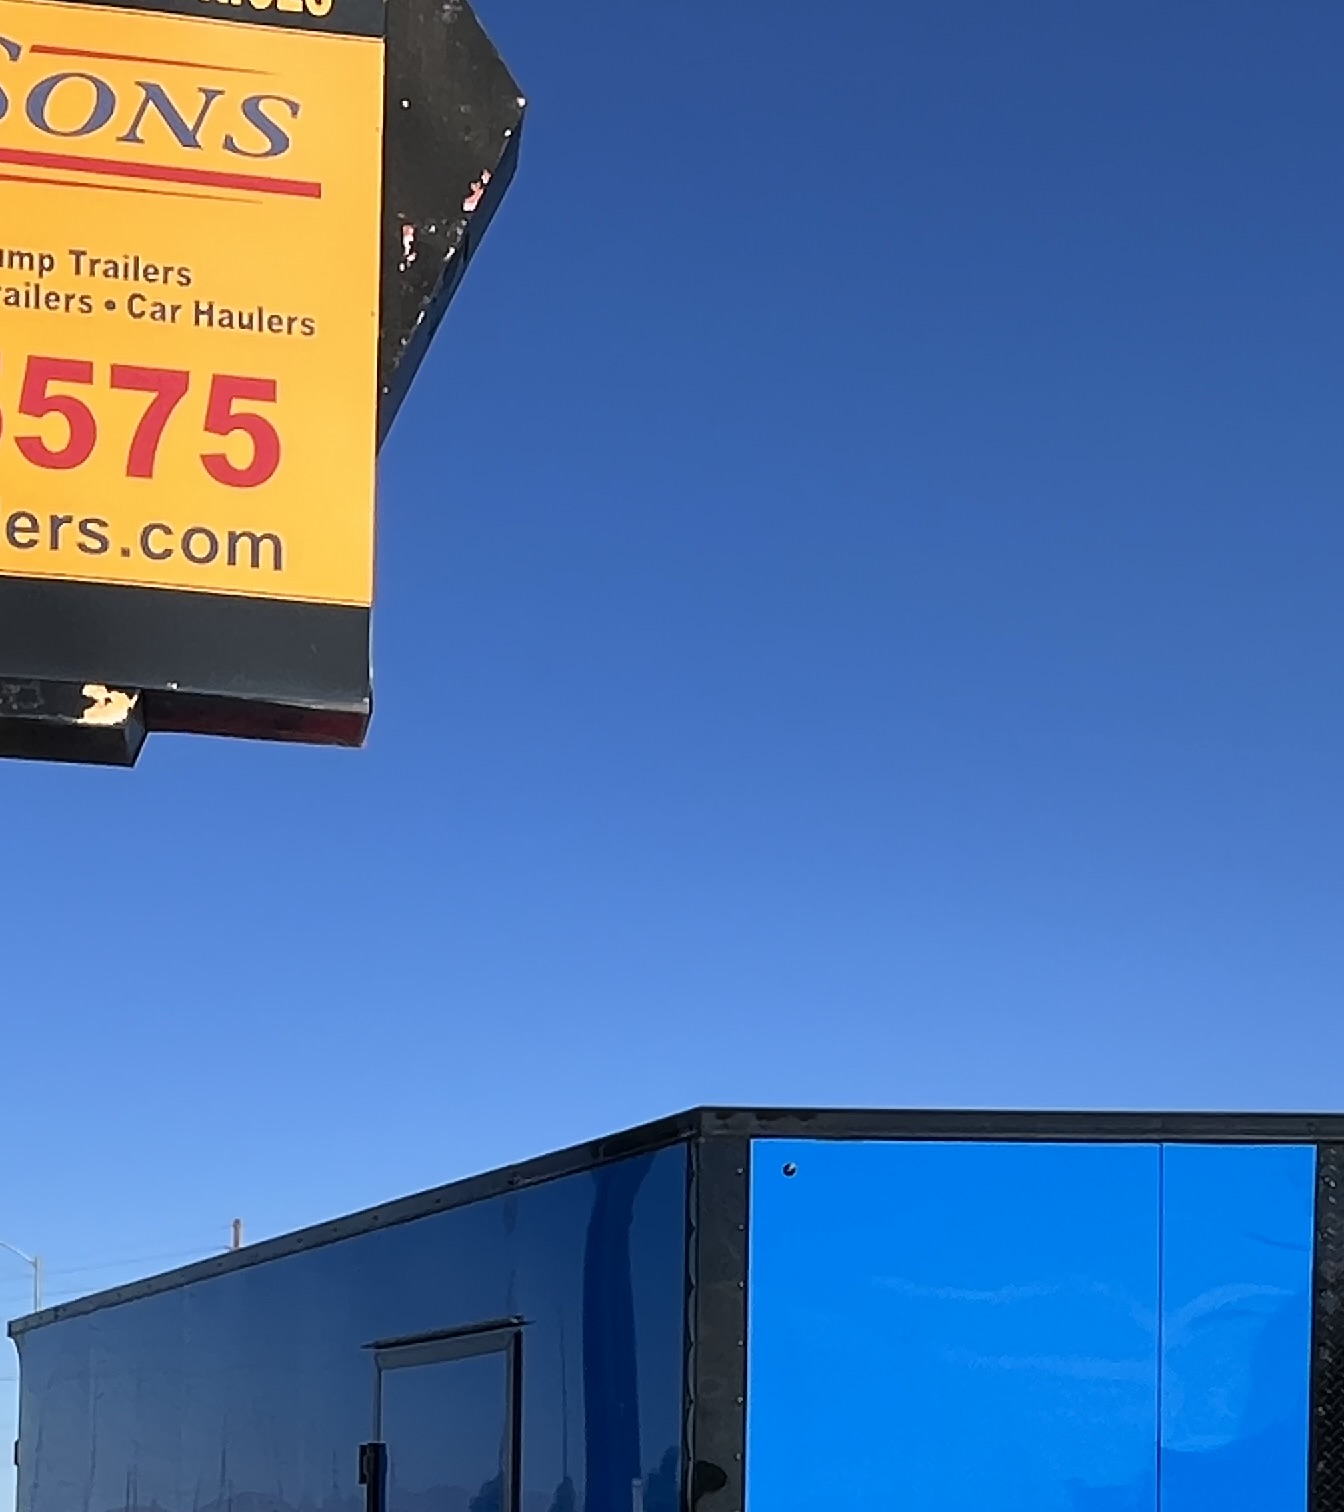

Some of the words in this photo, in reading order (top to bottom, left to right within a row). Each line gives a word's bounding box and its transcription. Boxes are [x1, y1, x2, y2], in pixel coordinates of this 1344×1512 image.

[68, 248, 193, 288] Trailers
[127, 294, 181, 324] Car
[193, 301, 316, 338] Haulers
